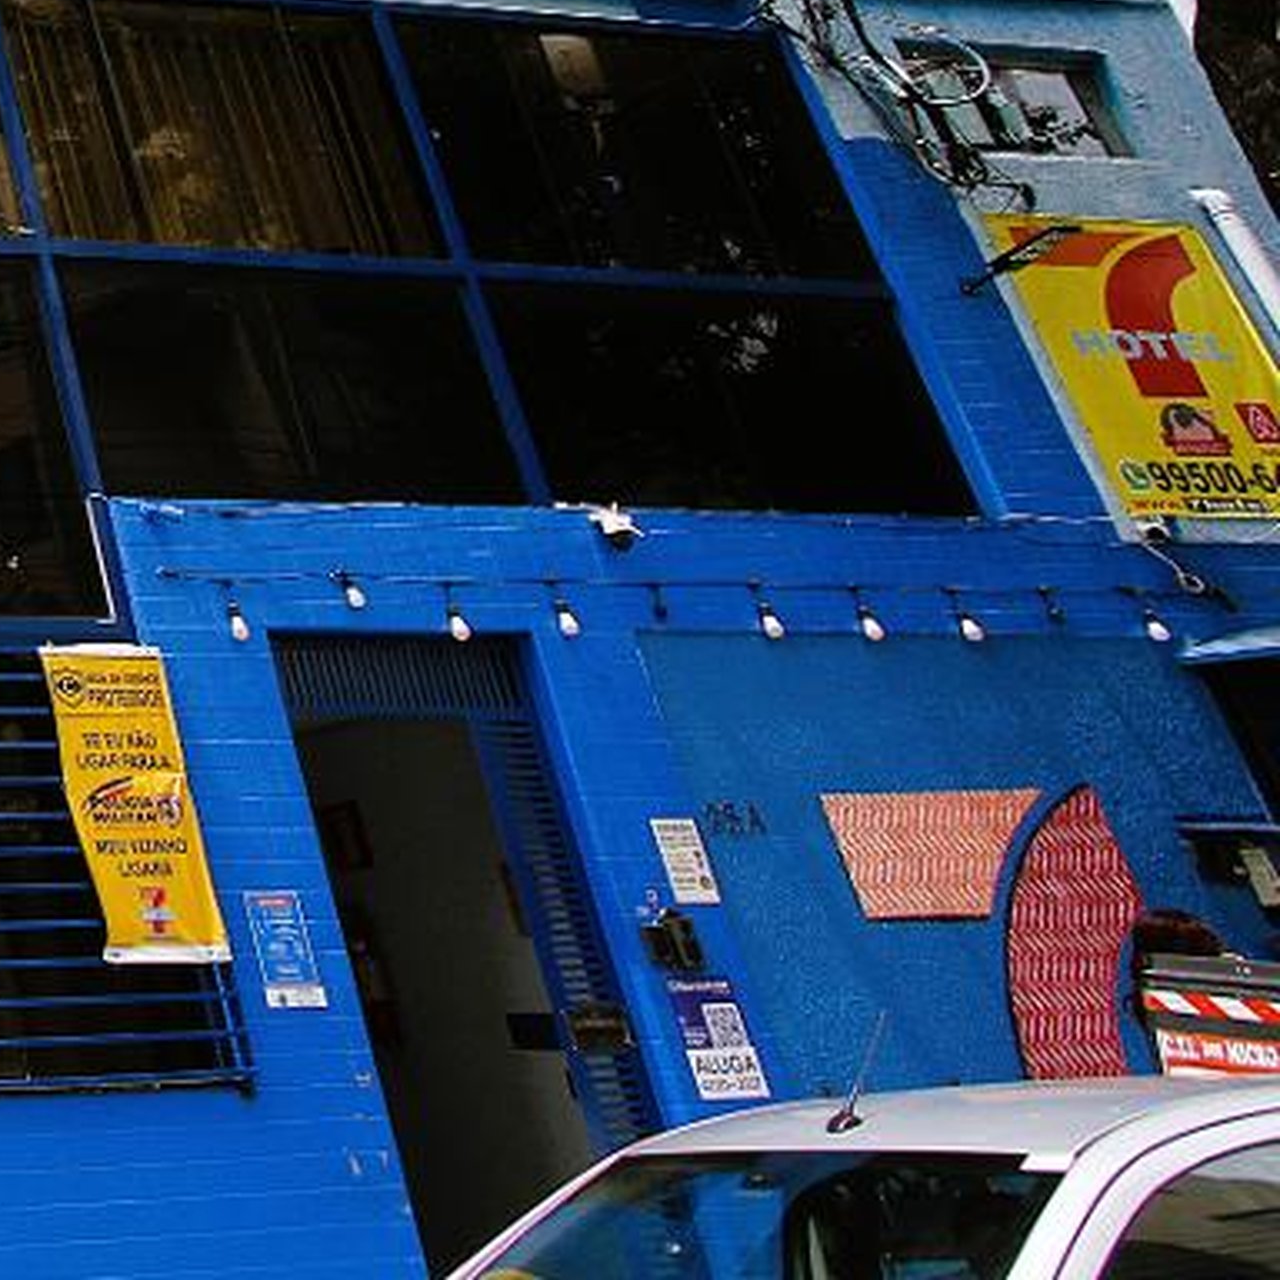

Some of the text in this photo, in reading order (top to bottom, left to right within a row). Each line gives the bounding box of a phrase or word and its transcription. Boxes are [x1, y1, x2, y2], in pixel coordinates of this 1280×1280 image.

[1071, 329, 1235, 361] HOTEL
[1146, 461, 1280, 494] 99500-6
[695, 1055, 758, 1075] ALUGA
